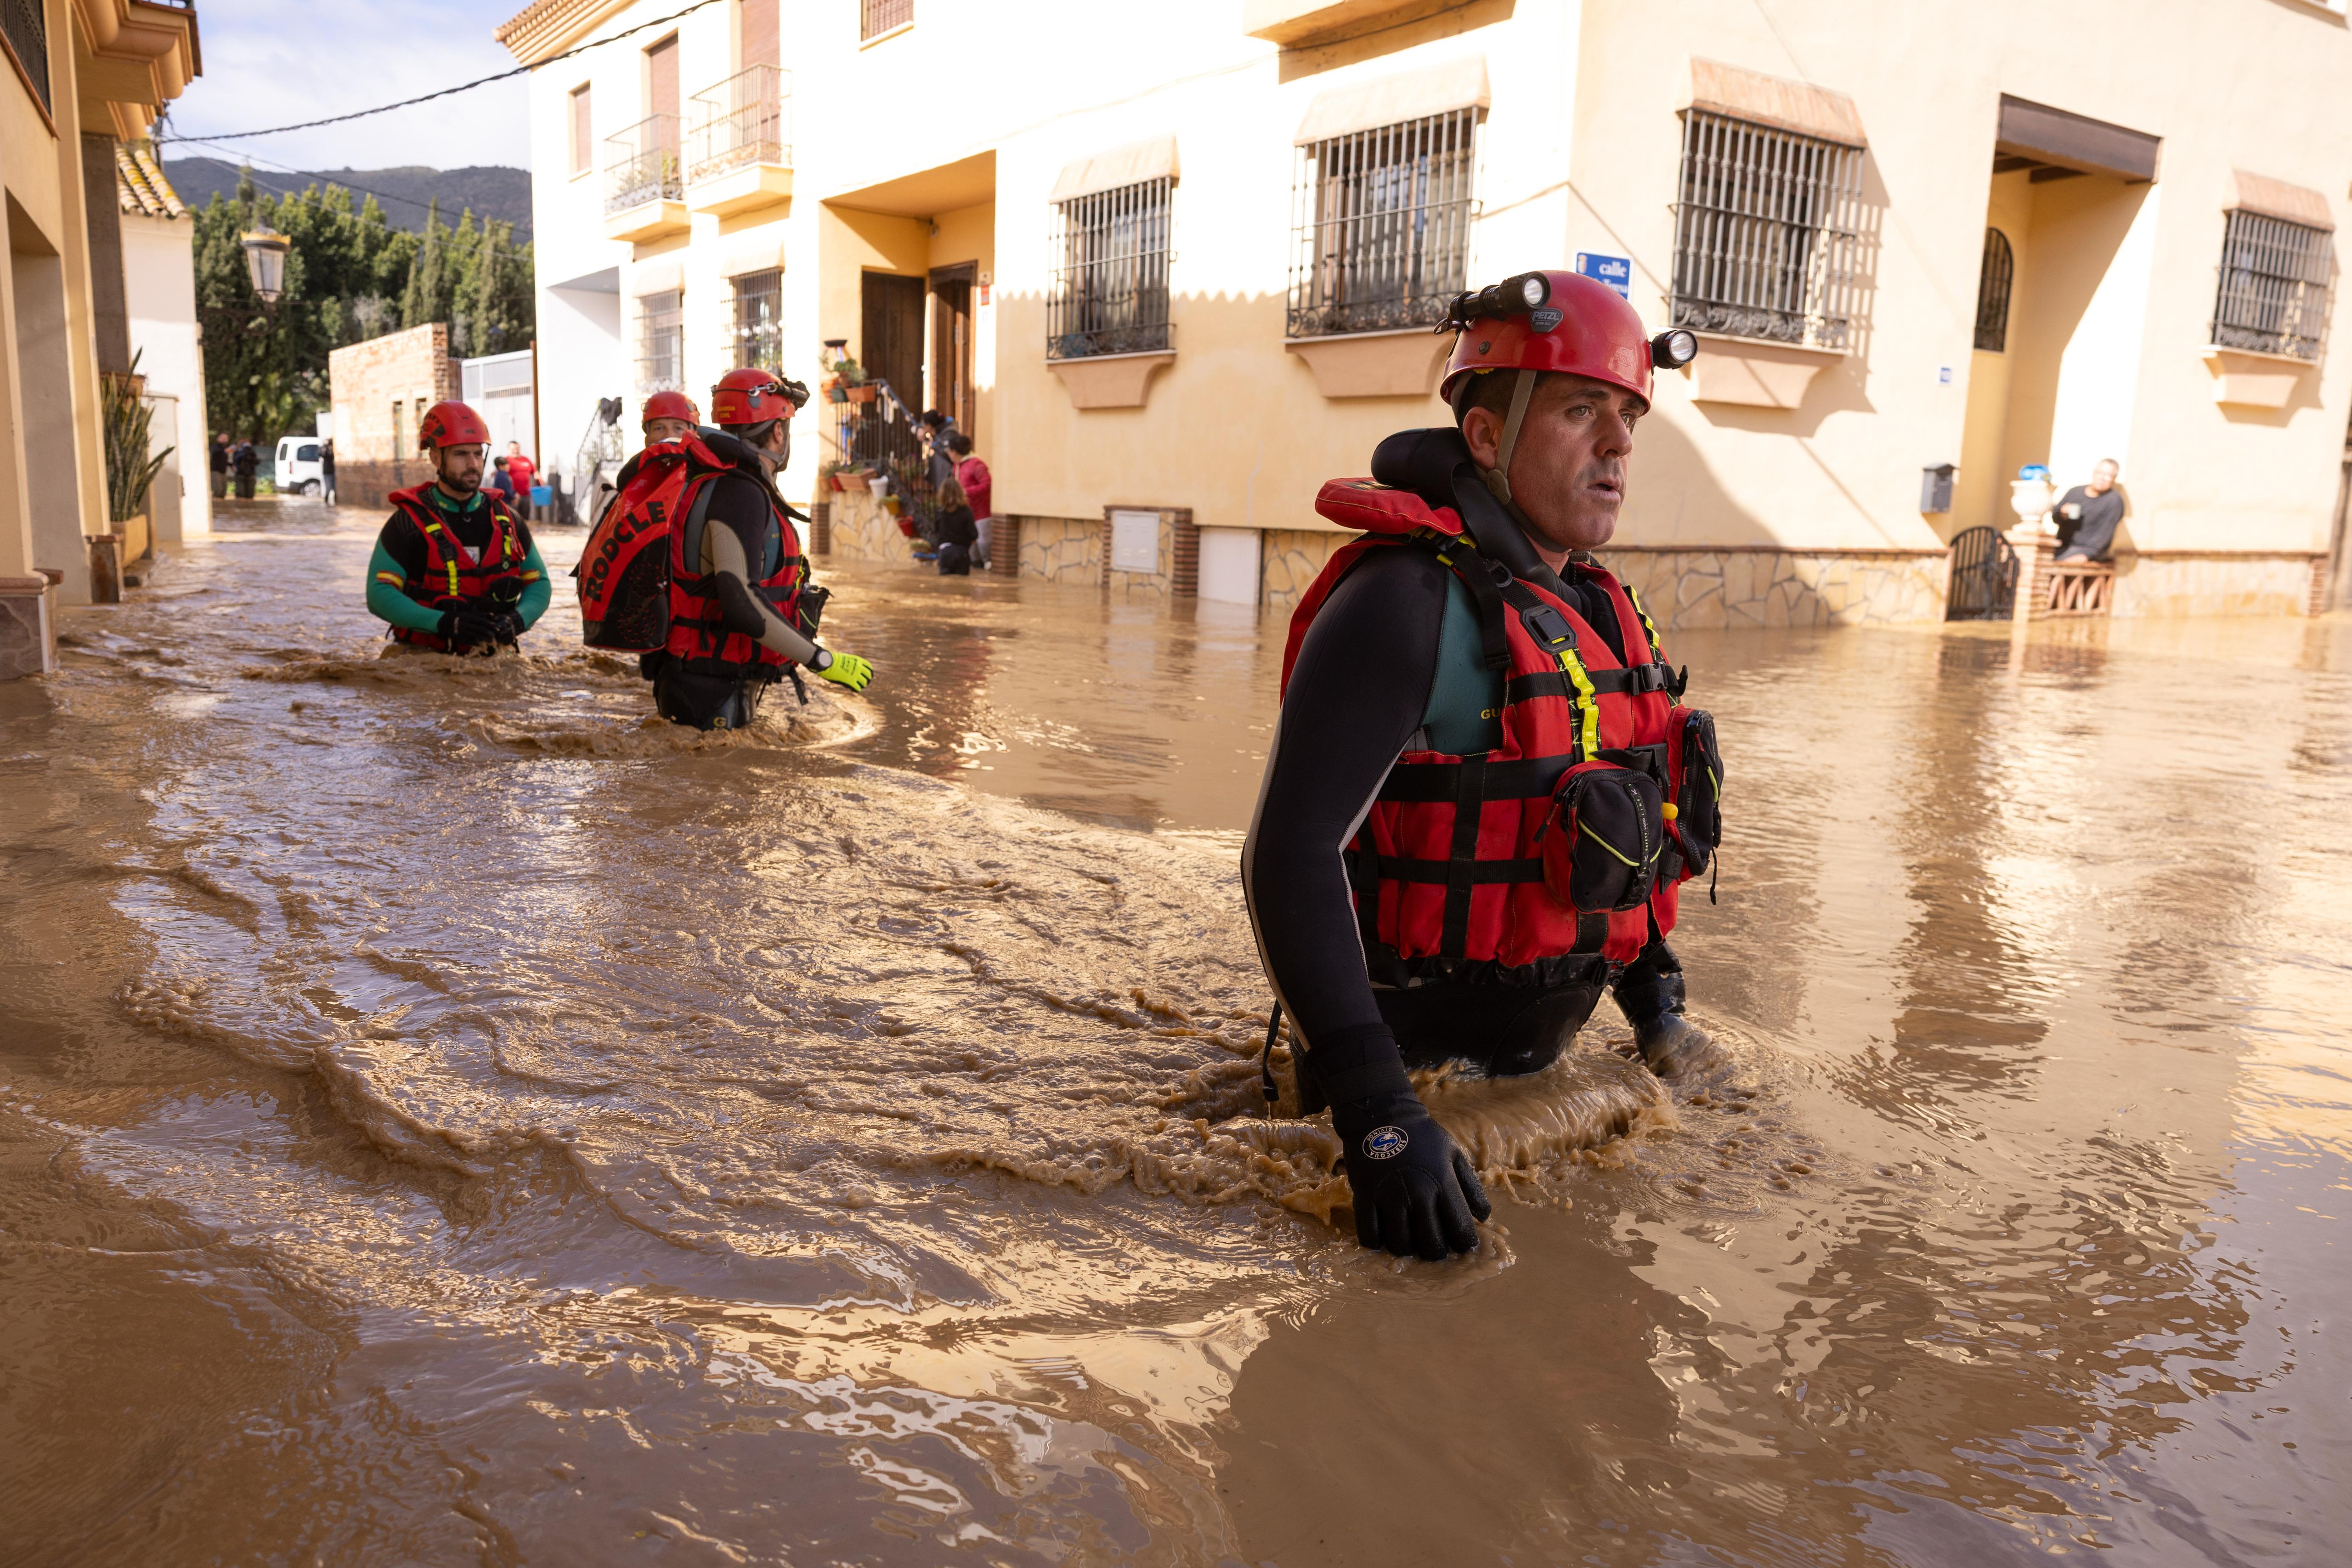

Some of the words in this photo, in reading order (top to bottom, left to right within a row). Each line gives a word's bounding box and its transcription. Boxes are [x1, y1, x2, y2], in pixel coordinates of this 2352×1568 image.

[1599, 261, 1627, 277] calle
[585, 501, 667, 602] RODCLE
[1369, 1127, 1392, 1138] DIVING
[1370, 1139, 1406, 1158] SUBACQUA
